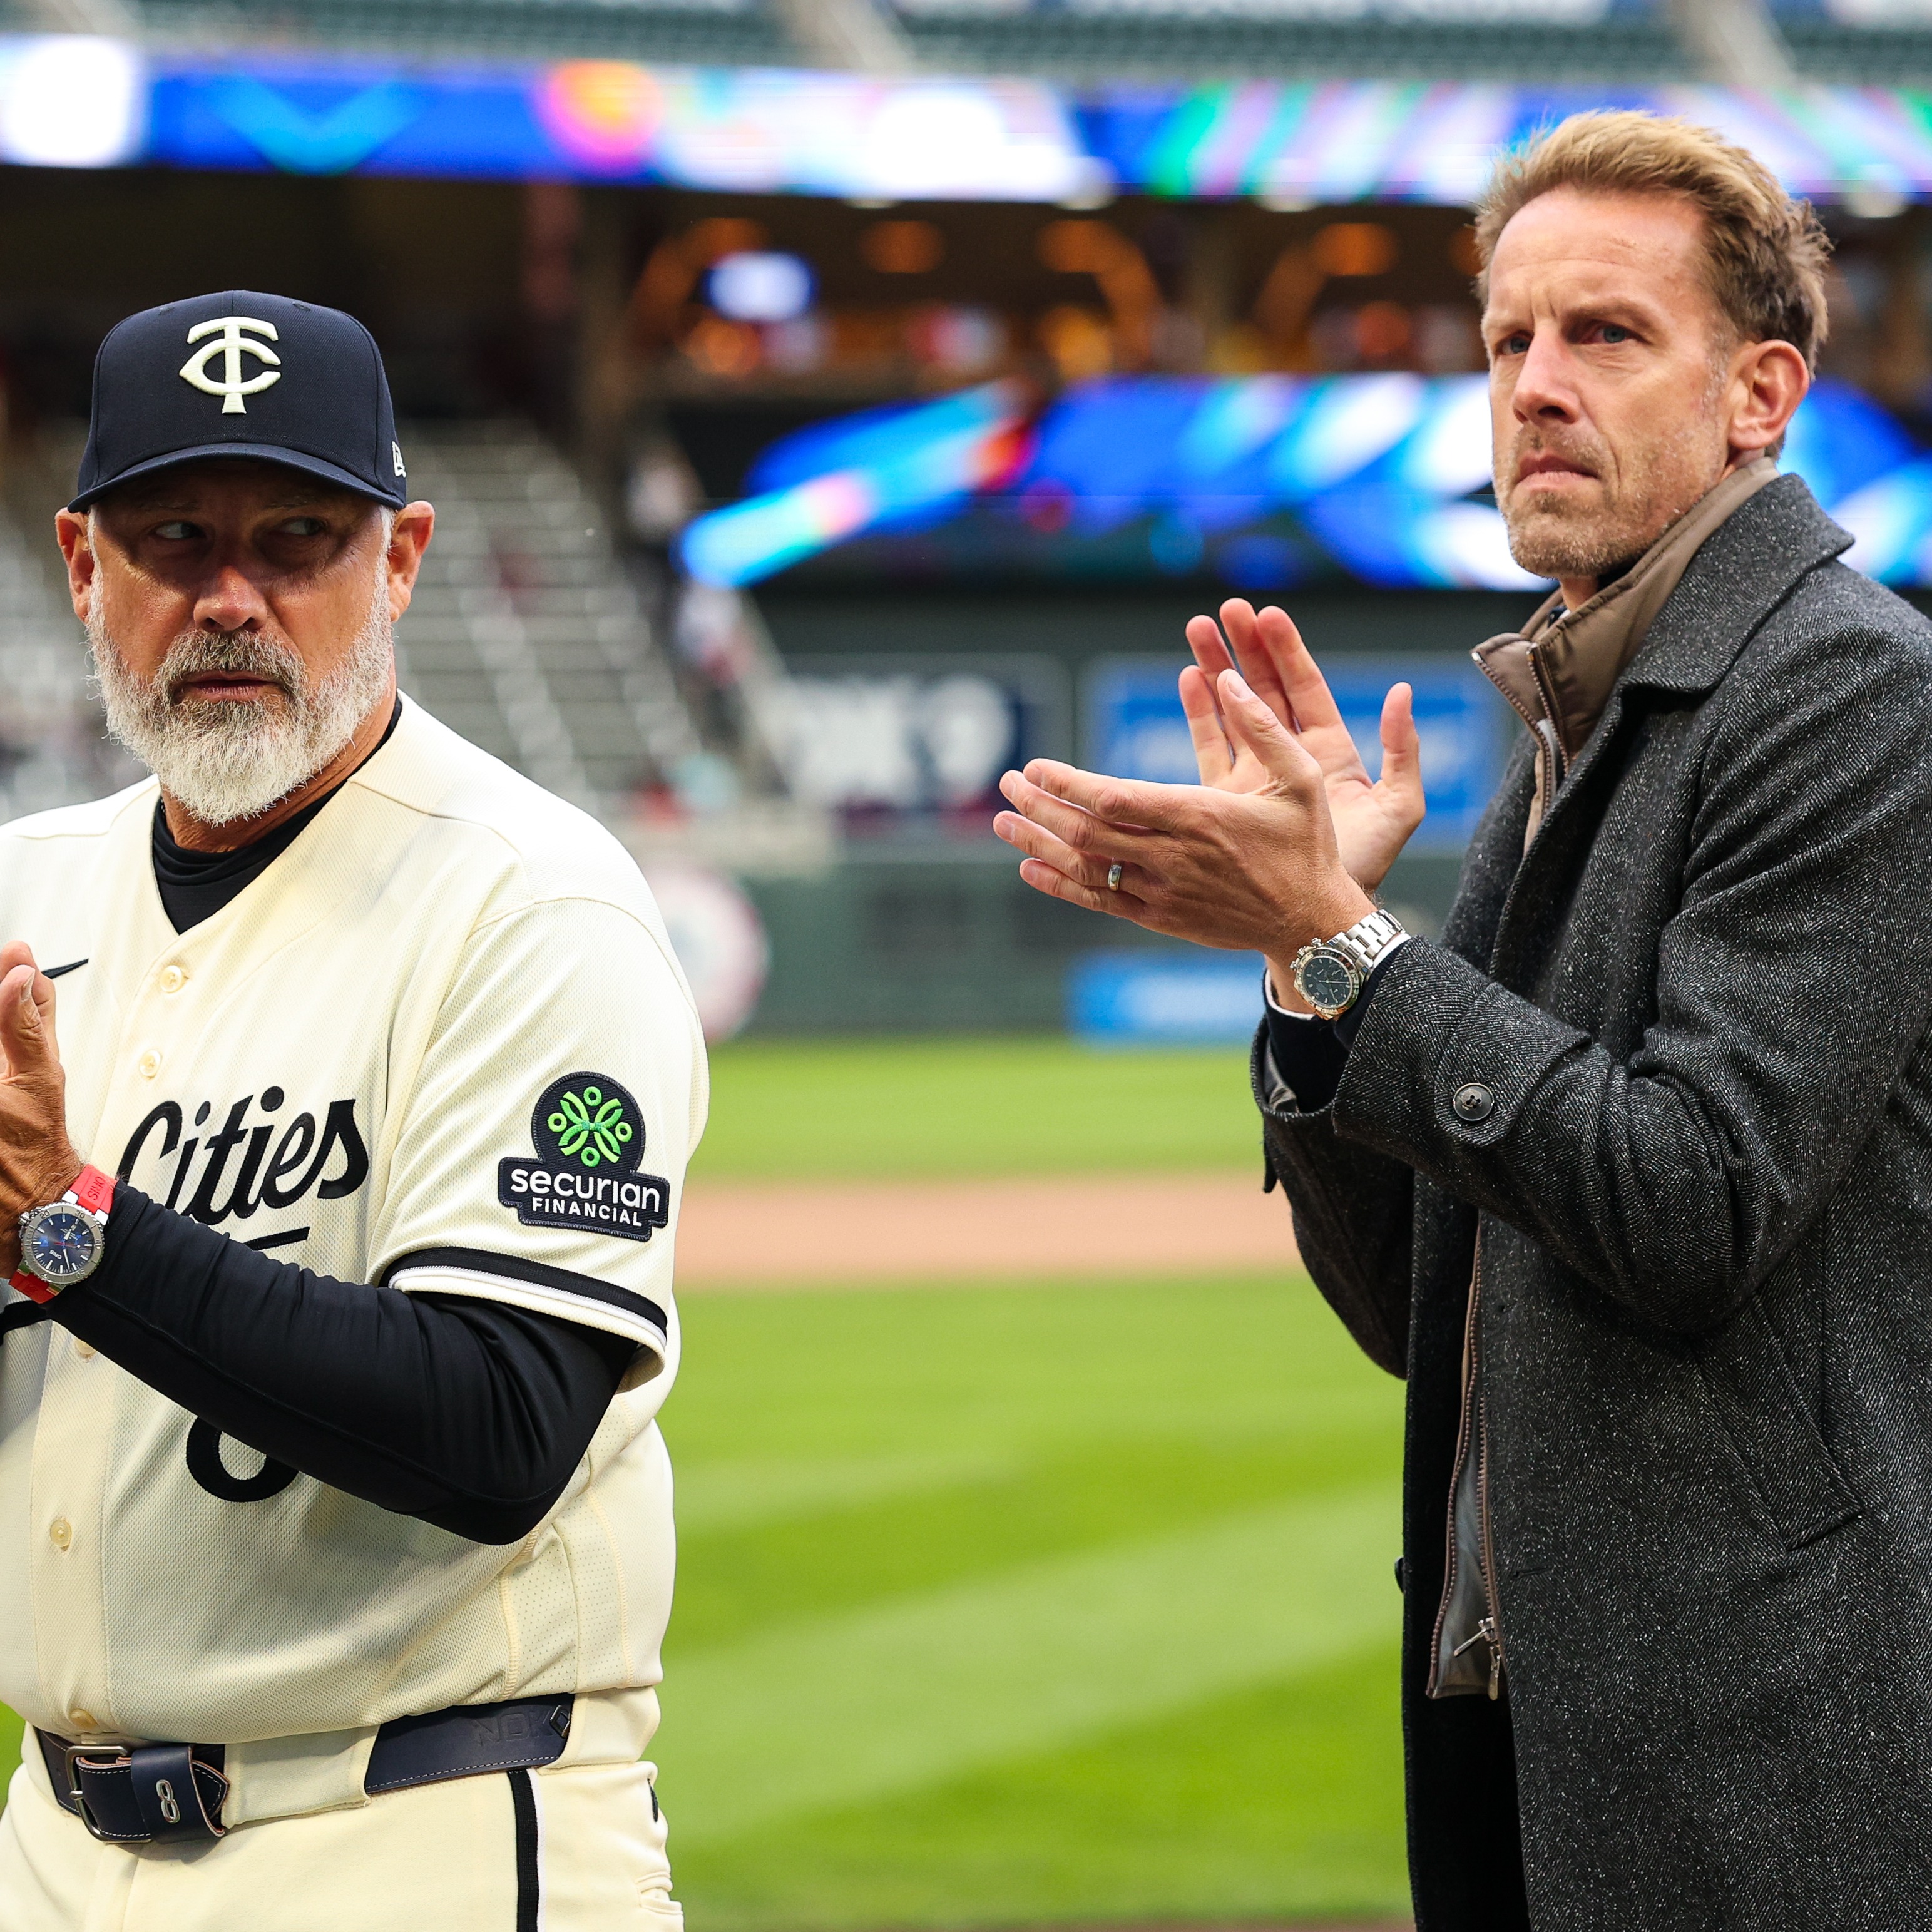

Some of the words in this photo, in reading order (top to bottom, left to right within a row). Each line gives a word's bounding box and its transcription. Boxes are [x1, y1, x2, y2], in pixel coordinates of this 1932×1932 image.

[116, 1085, 369, 1226] Cities
[88, 1176, 106, 1200] ORIS
[511, 1168, 660, 1212] securian
[39, 1210, 50, 1219] 20
[74, 1210, 85, 1219] 30
[533, 1197, 642, 1227] FINANCIAL
[49, 1249, 62, 1259] ORIS
[155, 1779, 180, 1824] 8
